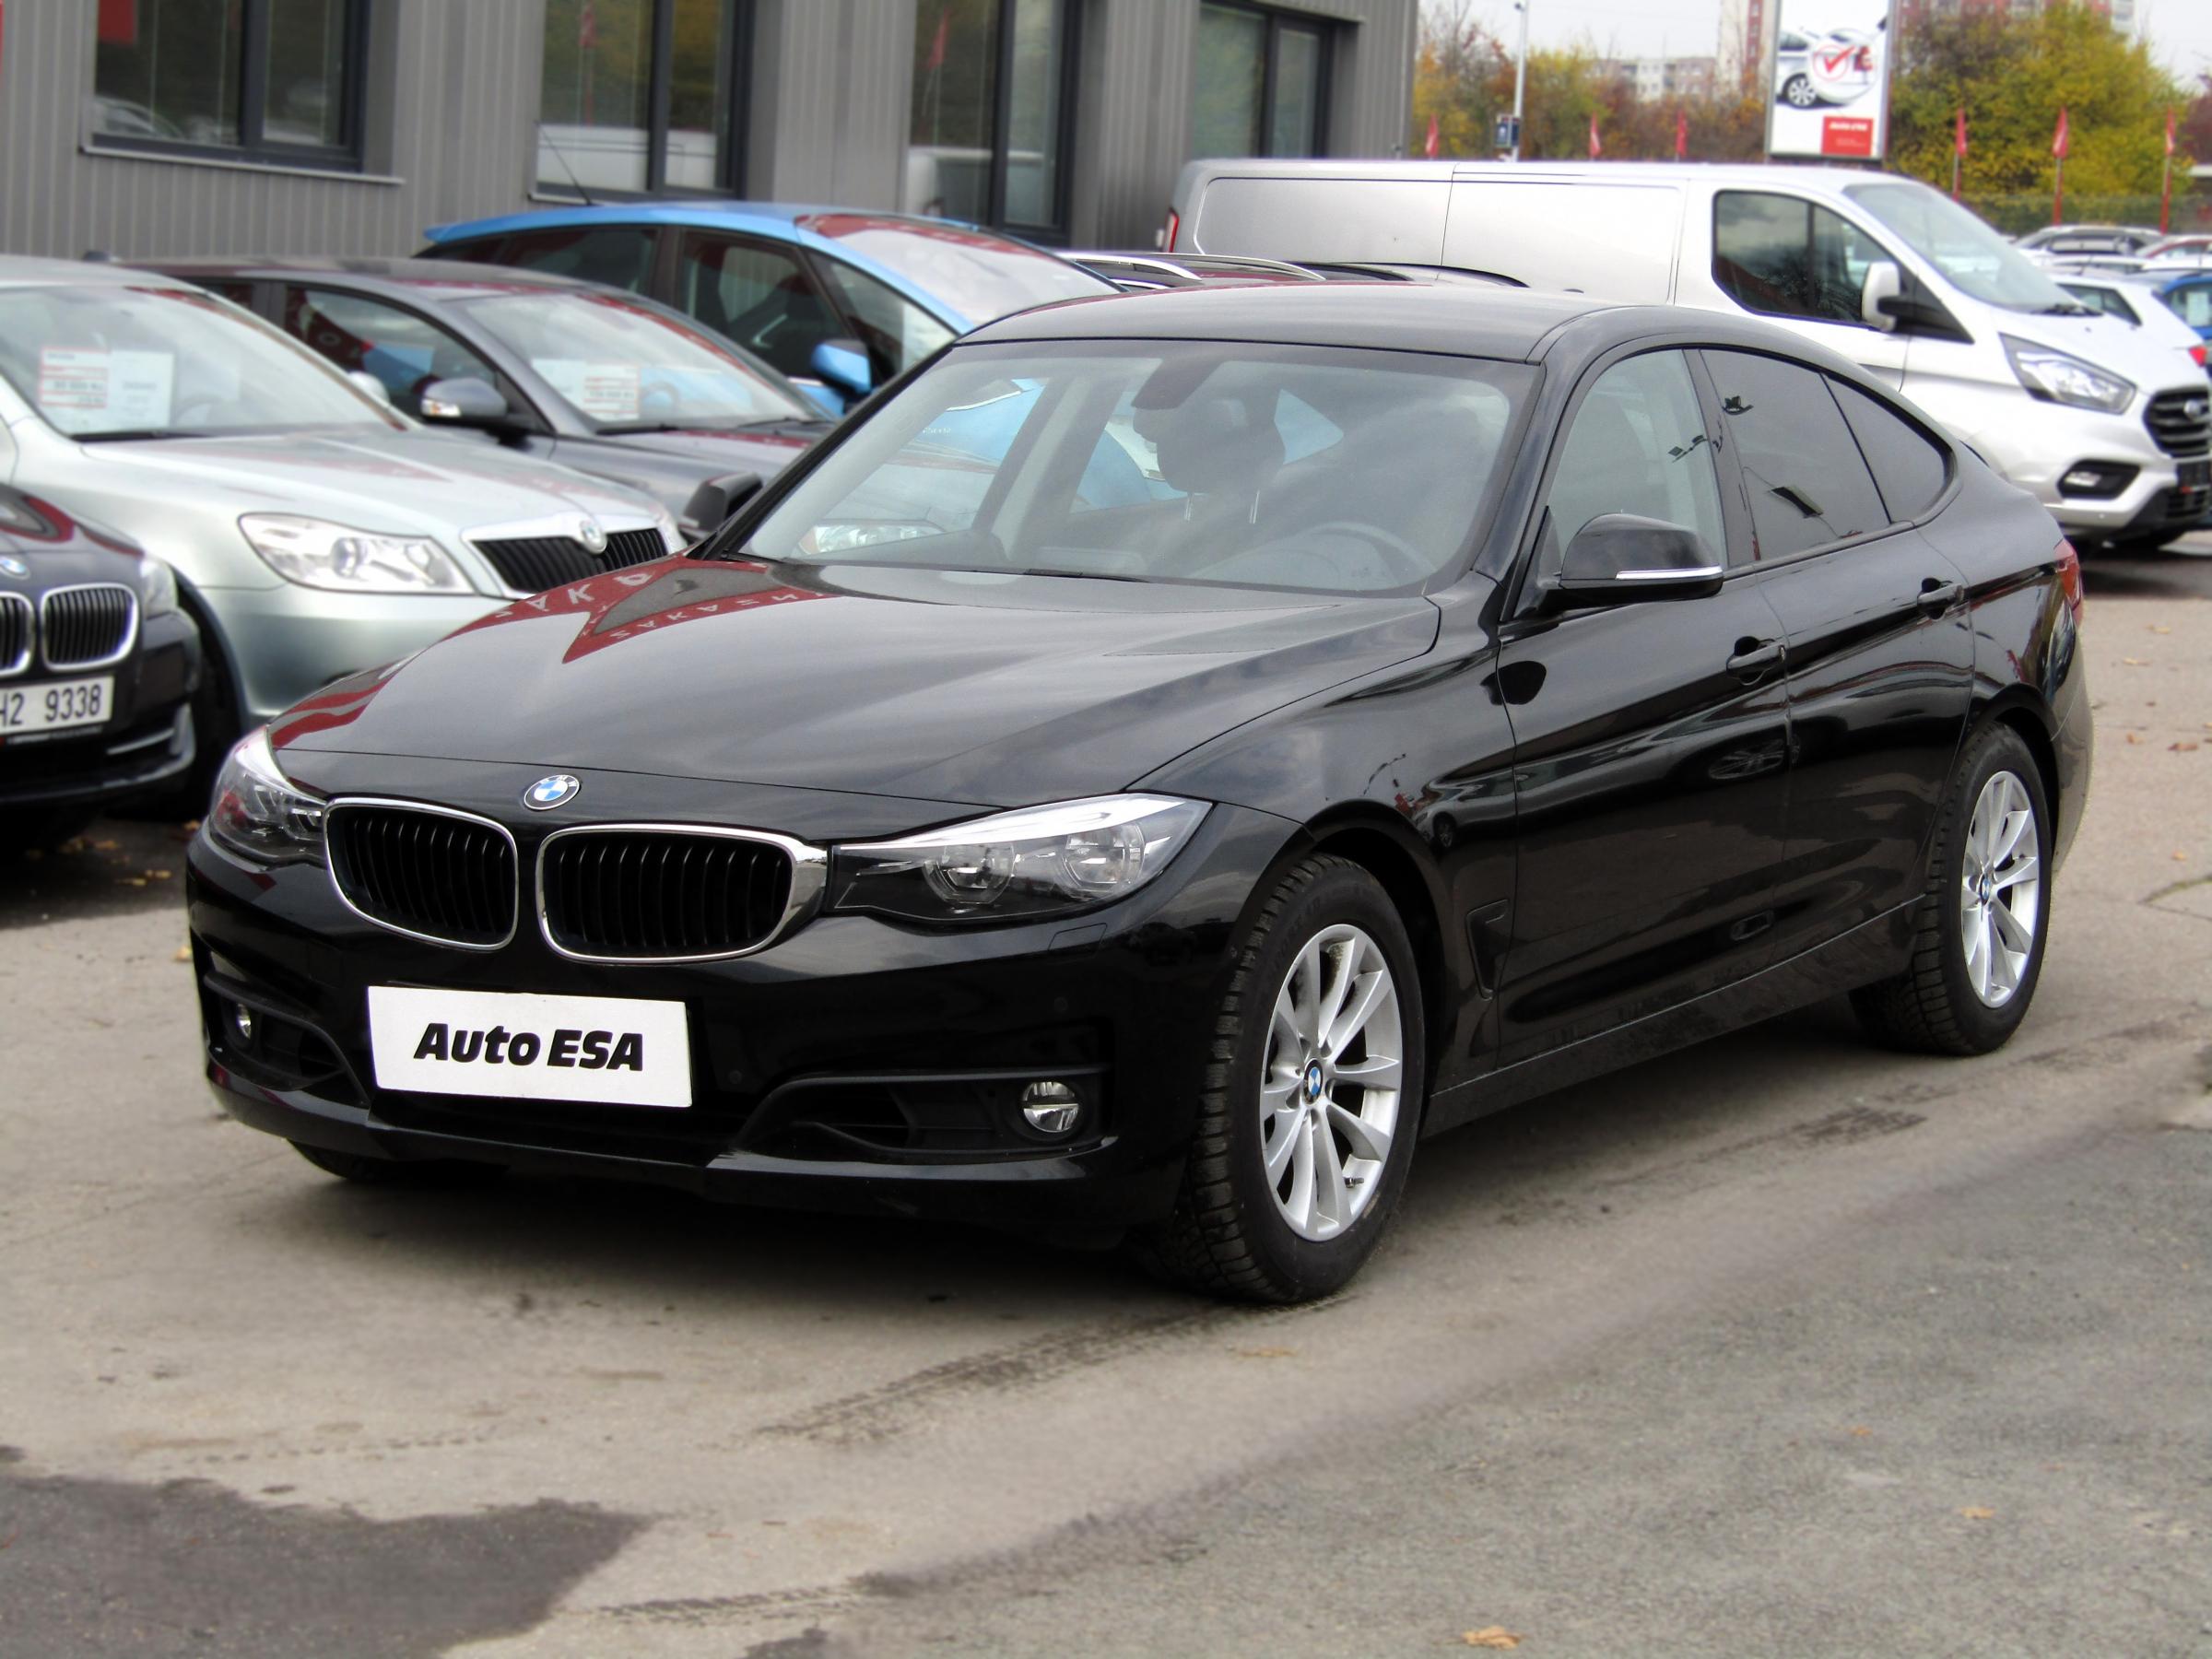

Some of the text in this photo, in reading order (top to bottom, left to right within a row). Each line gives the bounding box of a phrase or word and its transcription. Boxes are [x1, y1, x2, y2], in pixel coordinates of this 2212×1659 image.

[45, 684, 101, 723] 9338
[413, 1022, 643, 1071] Auto ESA
